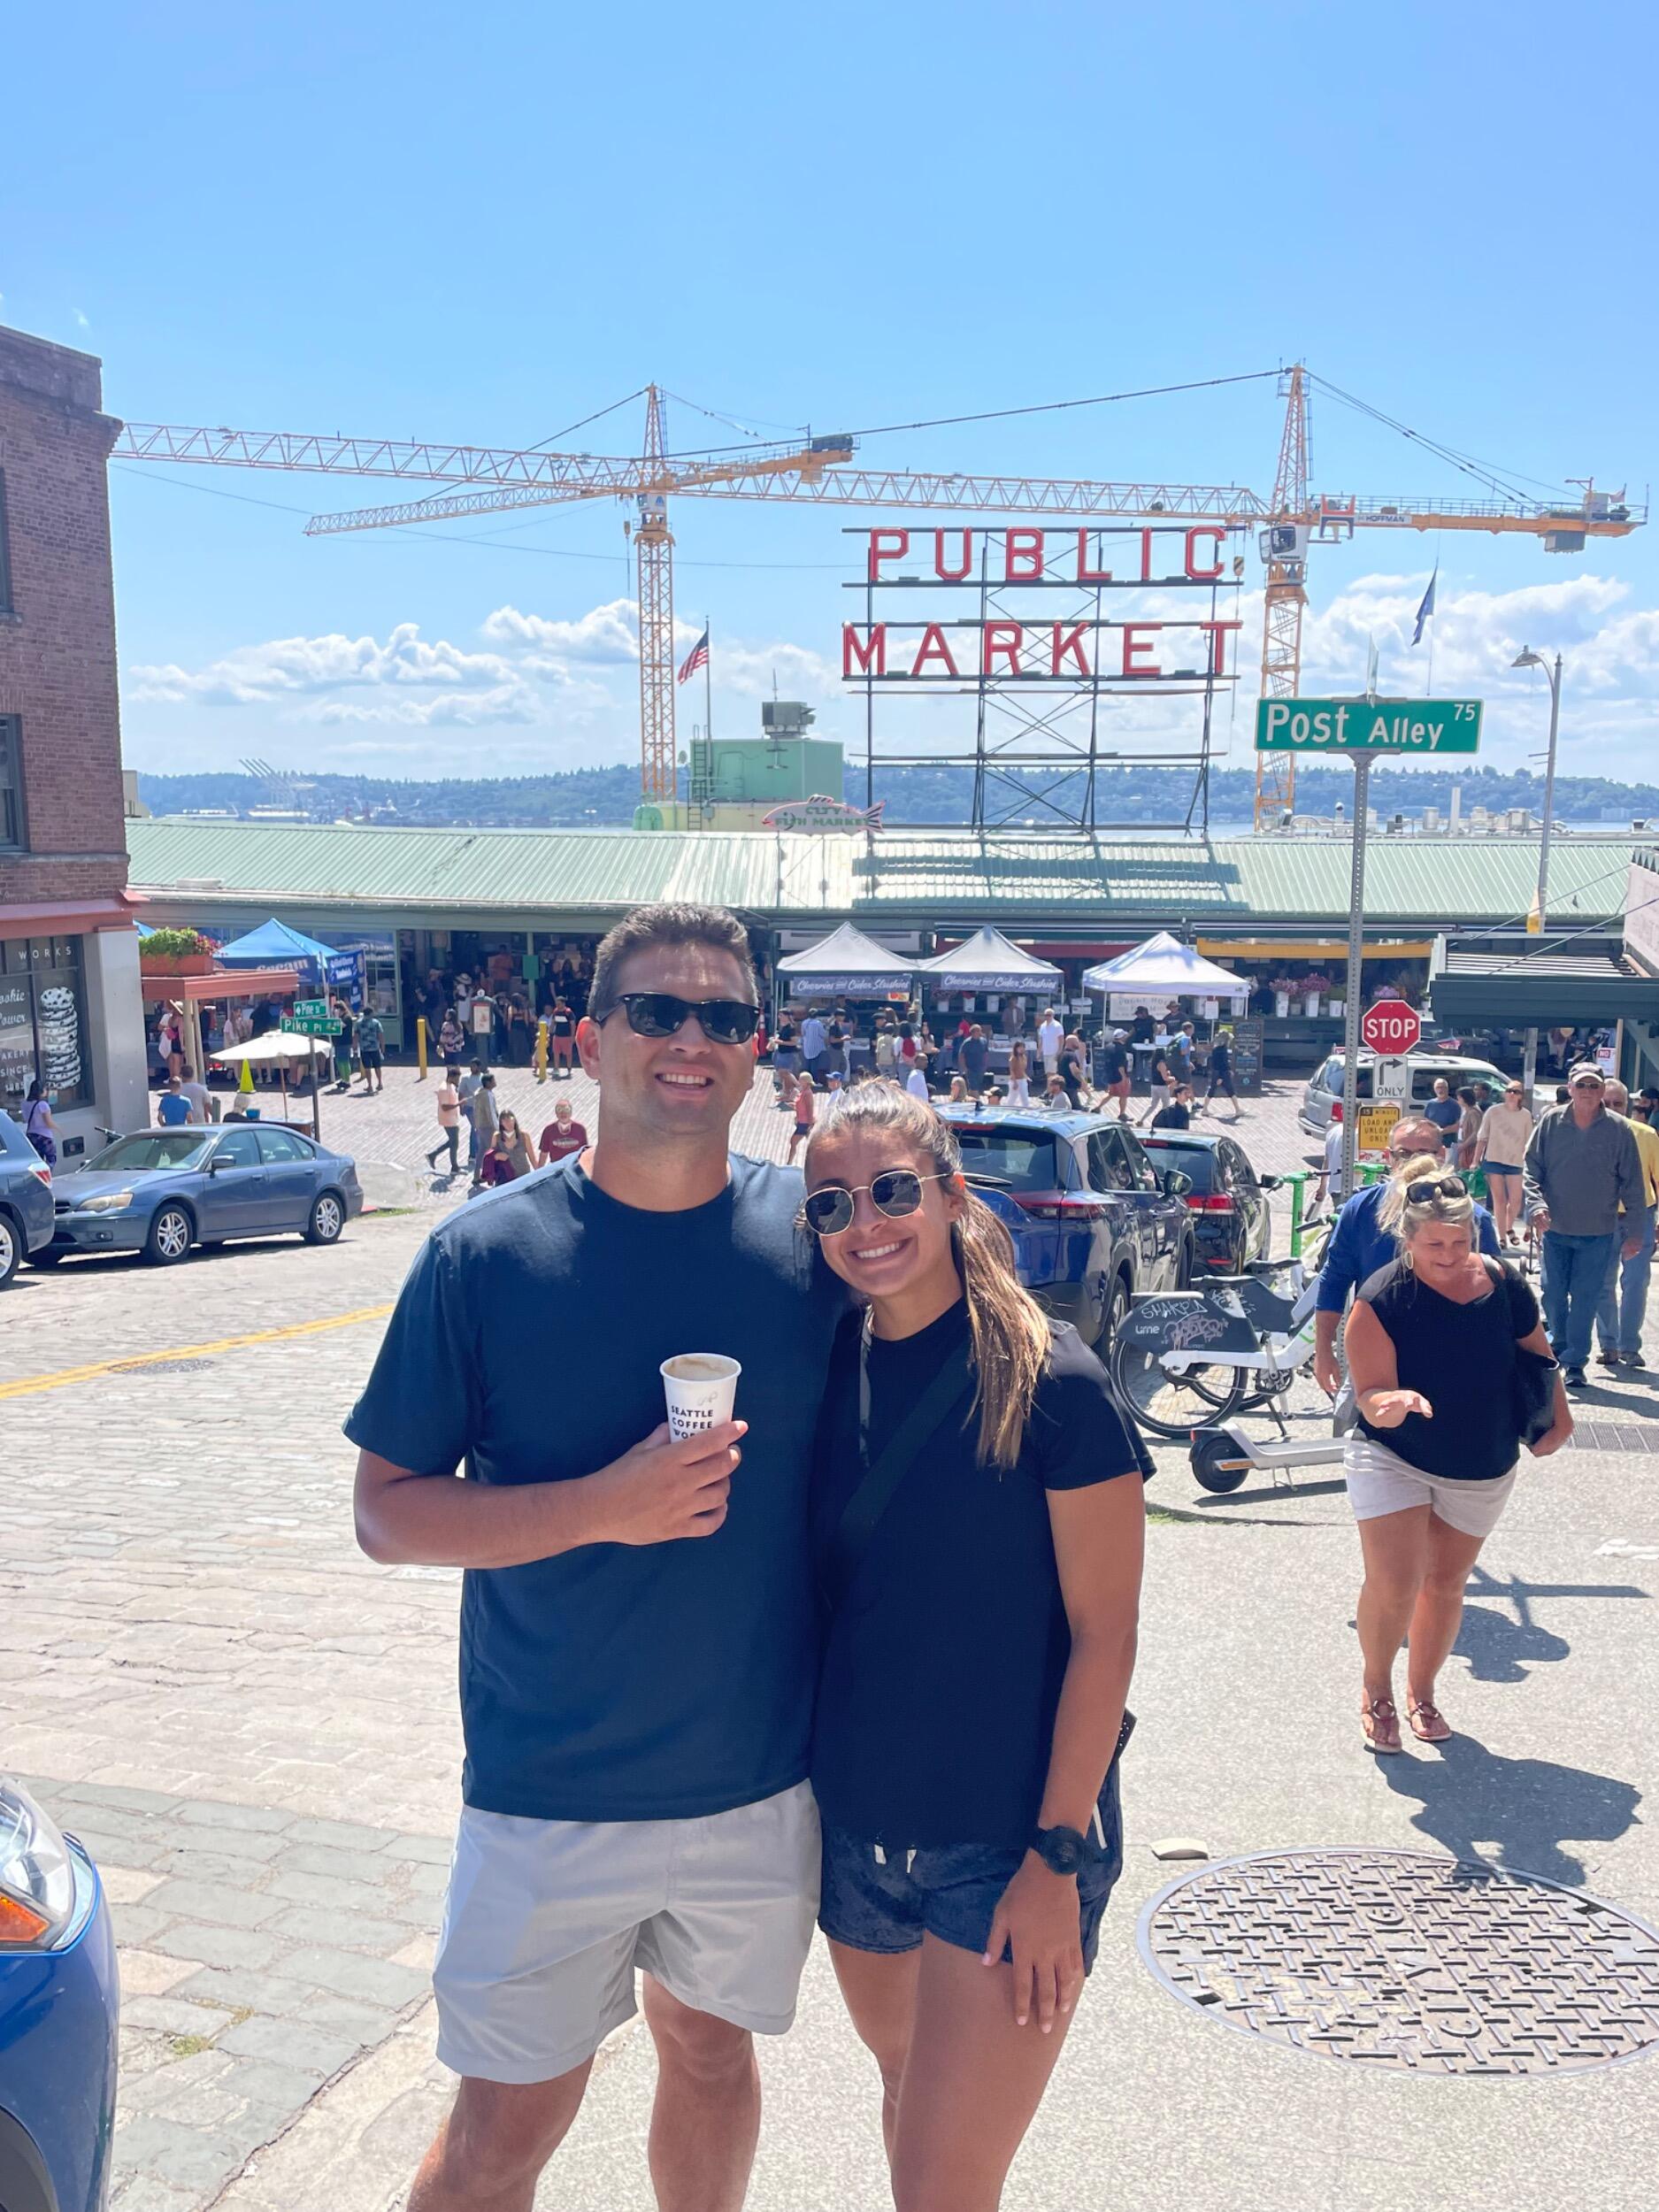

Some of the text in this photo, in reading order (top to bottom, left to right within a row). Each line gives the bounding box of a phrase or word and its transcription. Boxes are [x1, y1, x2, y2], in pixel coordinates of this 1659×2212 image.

[870, 526, 1226, 580] PUBLIC
[842, 619, 1243, 676] MARKET
[1266, 703, 1475, 749] Post Alley 75
[805, 806, 842, 815] CITY
[814, 817, 869, 826] MARKET
[19, 946, 72, 960] WORKS
[0, 987, 25, 1004] ookie
[284, 1019, 308, 1032] Pike
[1366, 1018, 1416, 1039] STOP
[1, 1048, 29, 1061] AKERY
[0, 1064, 28, 1078] SINCE
[1377, 1087, 1404, 1096] ONLY
[672, 1405, 714, 1417] SEATTLE
[672, 1417, 713, 1429] COFFEE
